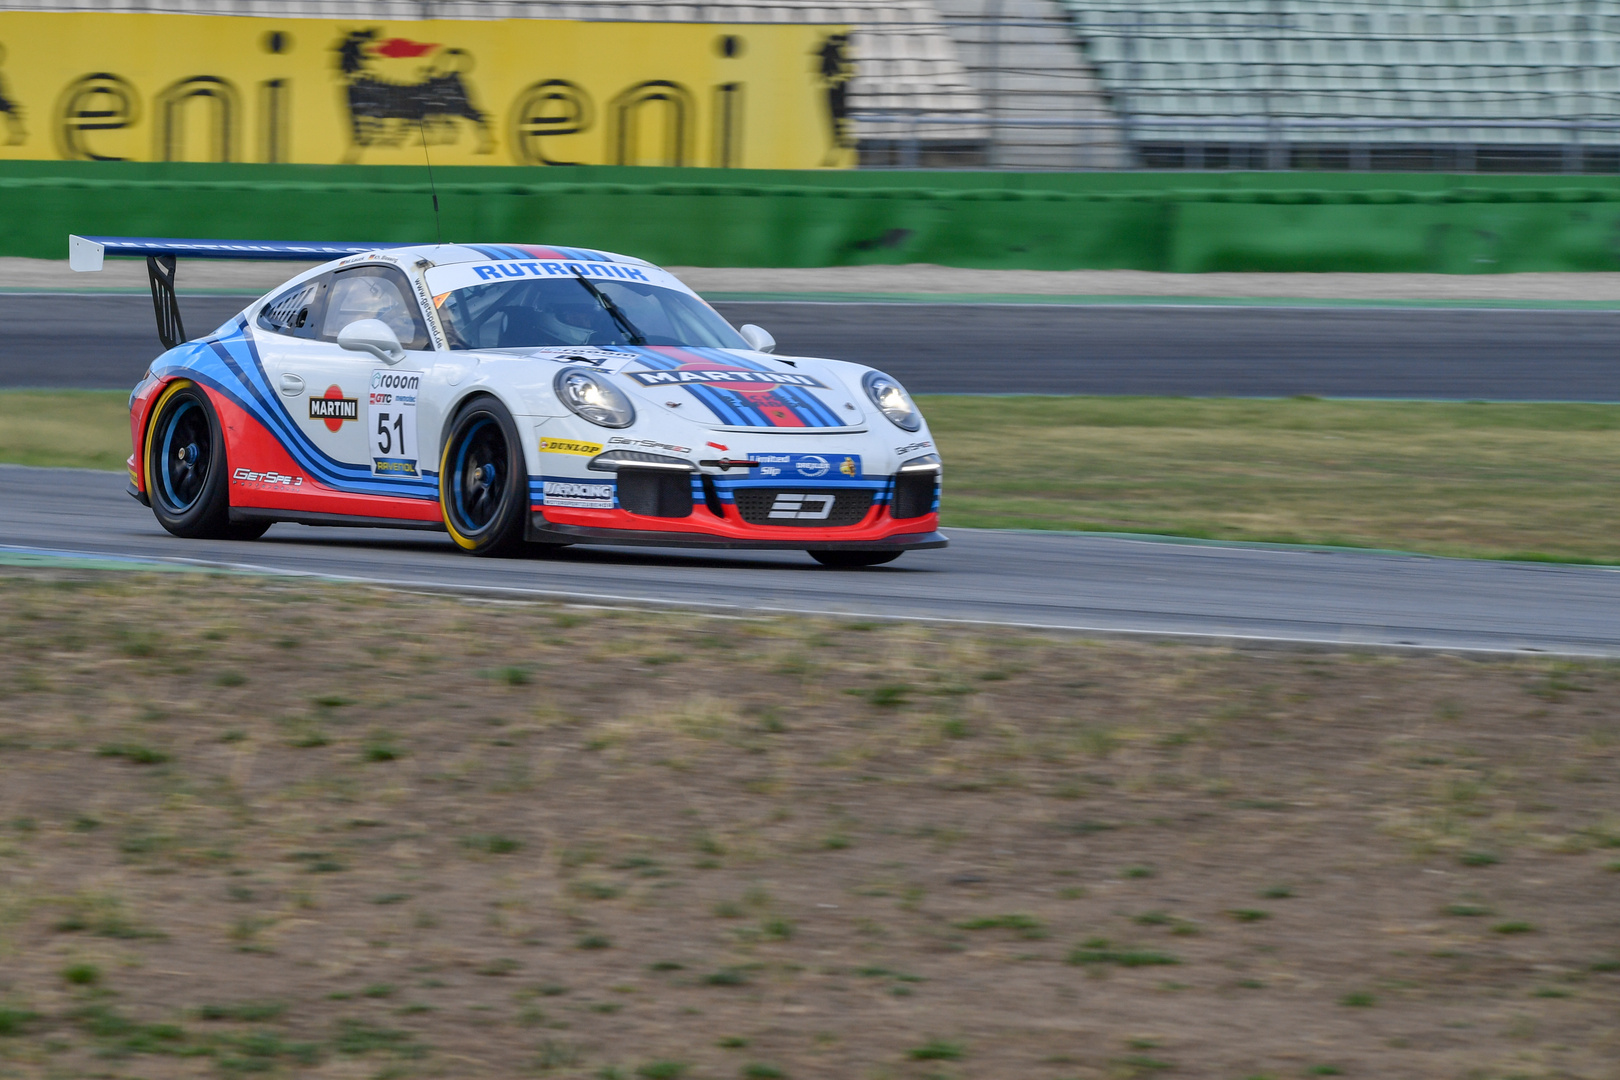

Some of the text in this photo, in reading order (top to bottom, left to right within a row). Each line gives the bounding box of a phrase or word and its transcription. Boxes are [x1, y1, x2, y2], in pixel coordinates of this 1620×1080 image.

[52, 30, 293, 163] eni
[504, 34, 746, 168] eni
[472, 262, 650, 282] RUTRONIK
[380, 374, 419, 390] rooom
[638, 371, 816, 387] MARTINI
[311, 401, 356, 417] MARTINI
[377, 412, 406, 455] 51
[549, 441, 600, 454] DUNLOP
[376, 461, 416, 473] RAVENOL
[760, 466, 781, 476] Slip
